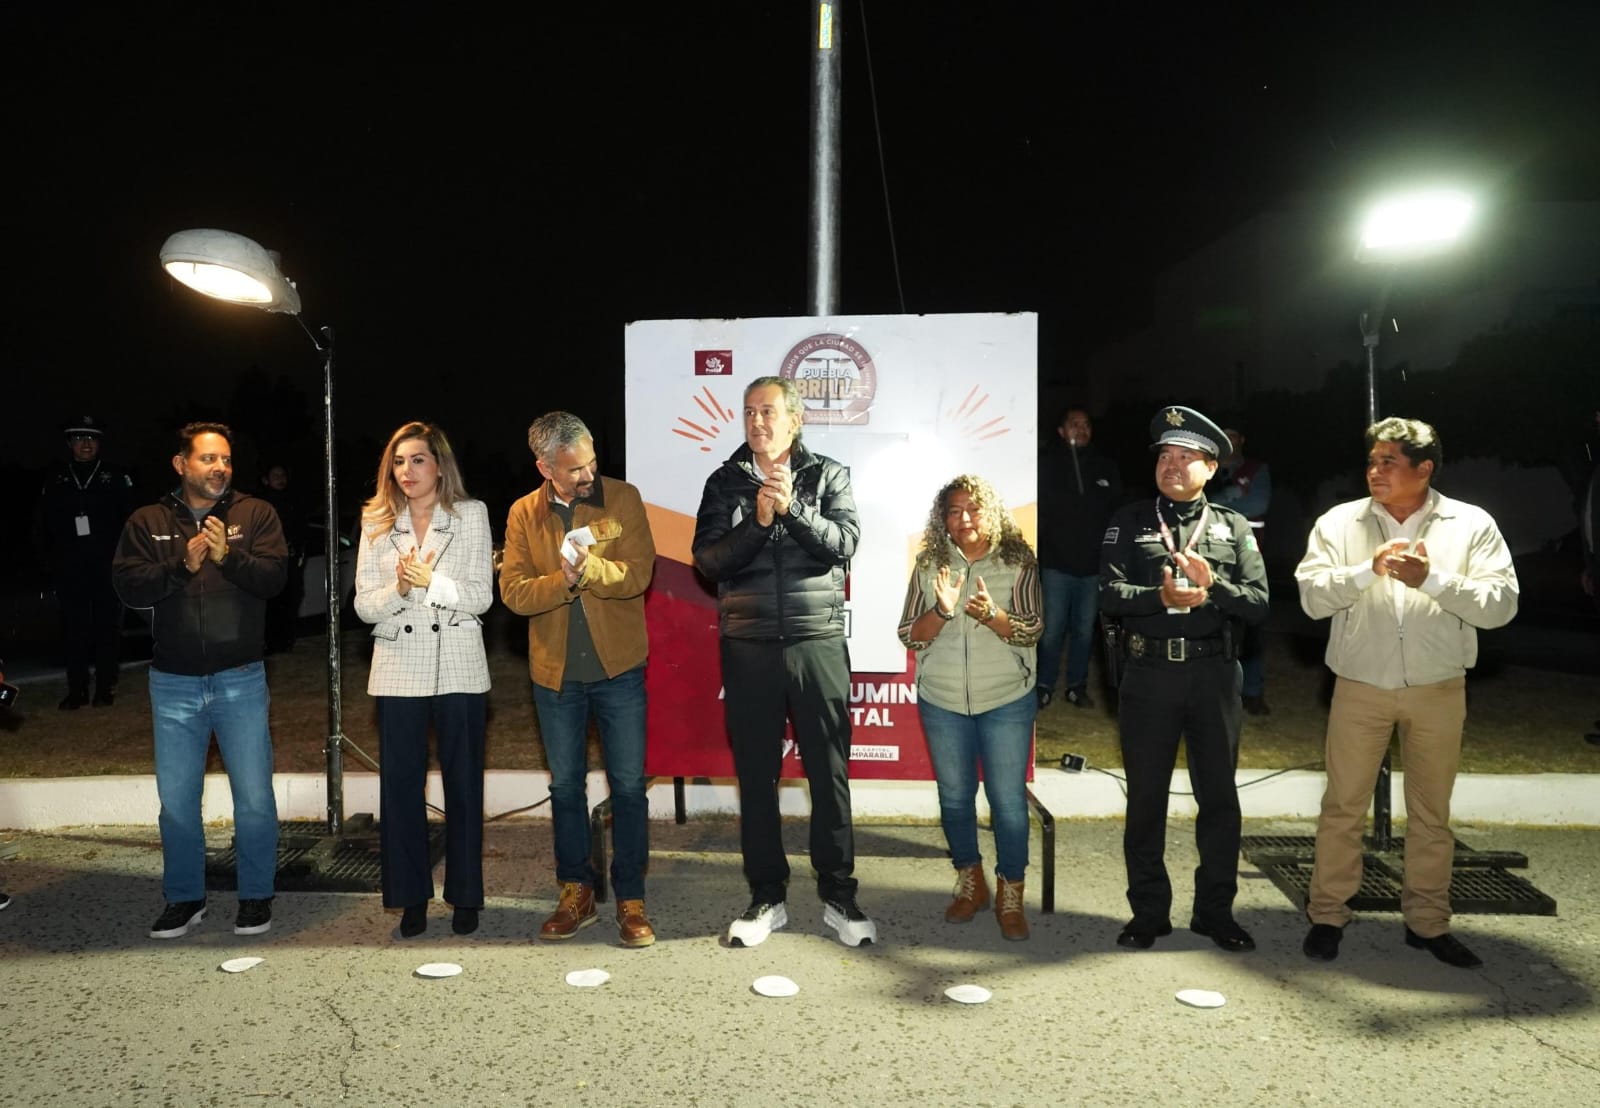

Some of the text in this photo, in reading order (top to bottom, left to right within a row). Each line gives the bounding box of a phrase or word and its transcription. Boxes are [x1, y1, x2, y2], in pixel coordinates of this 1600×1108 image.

[798, 344, 813, 355] QUE
[814, 339, 824, 347] LA
[803, 368, 851, 378] PUEBLA
[850, 682, 918, 704] UMIN
[850, 707, 894, 727] TAL
[851, 751, 894, 759] MPARABLE
